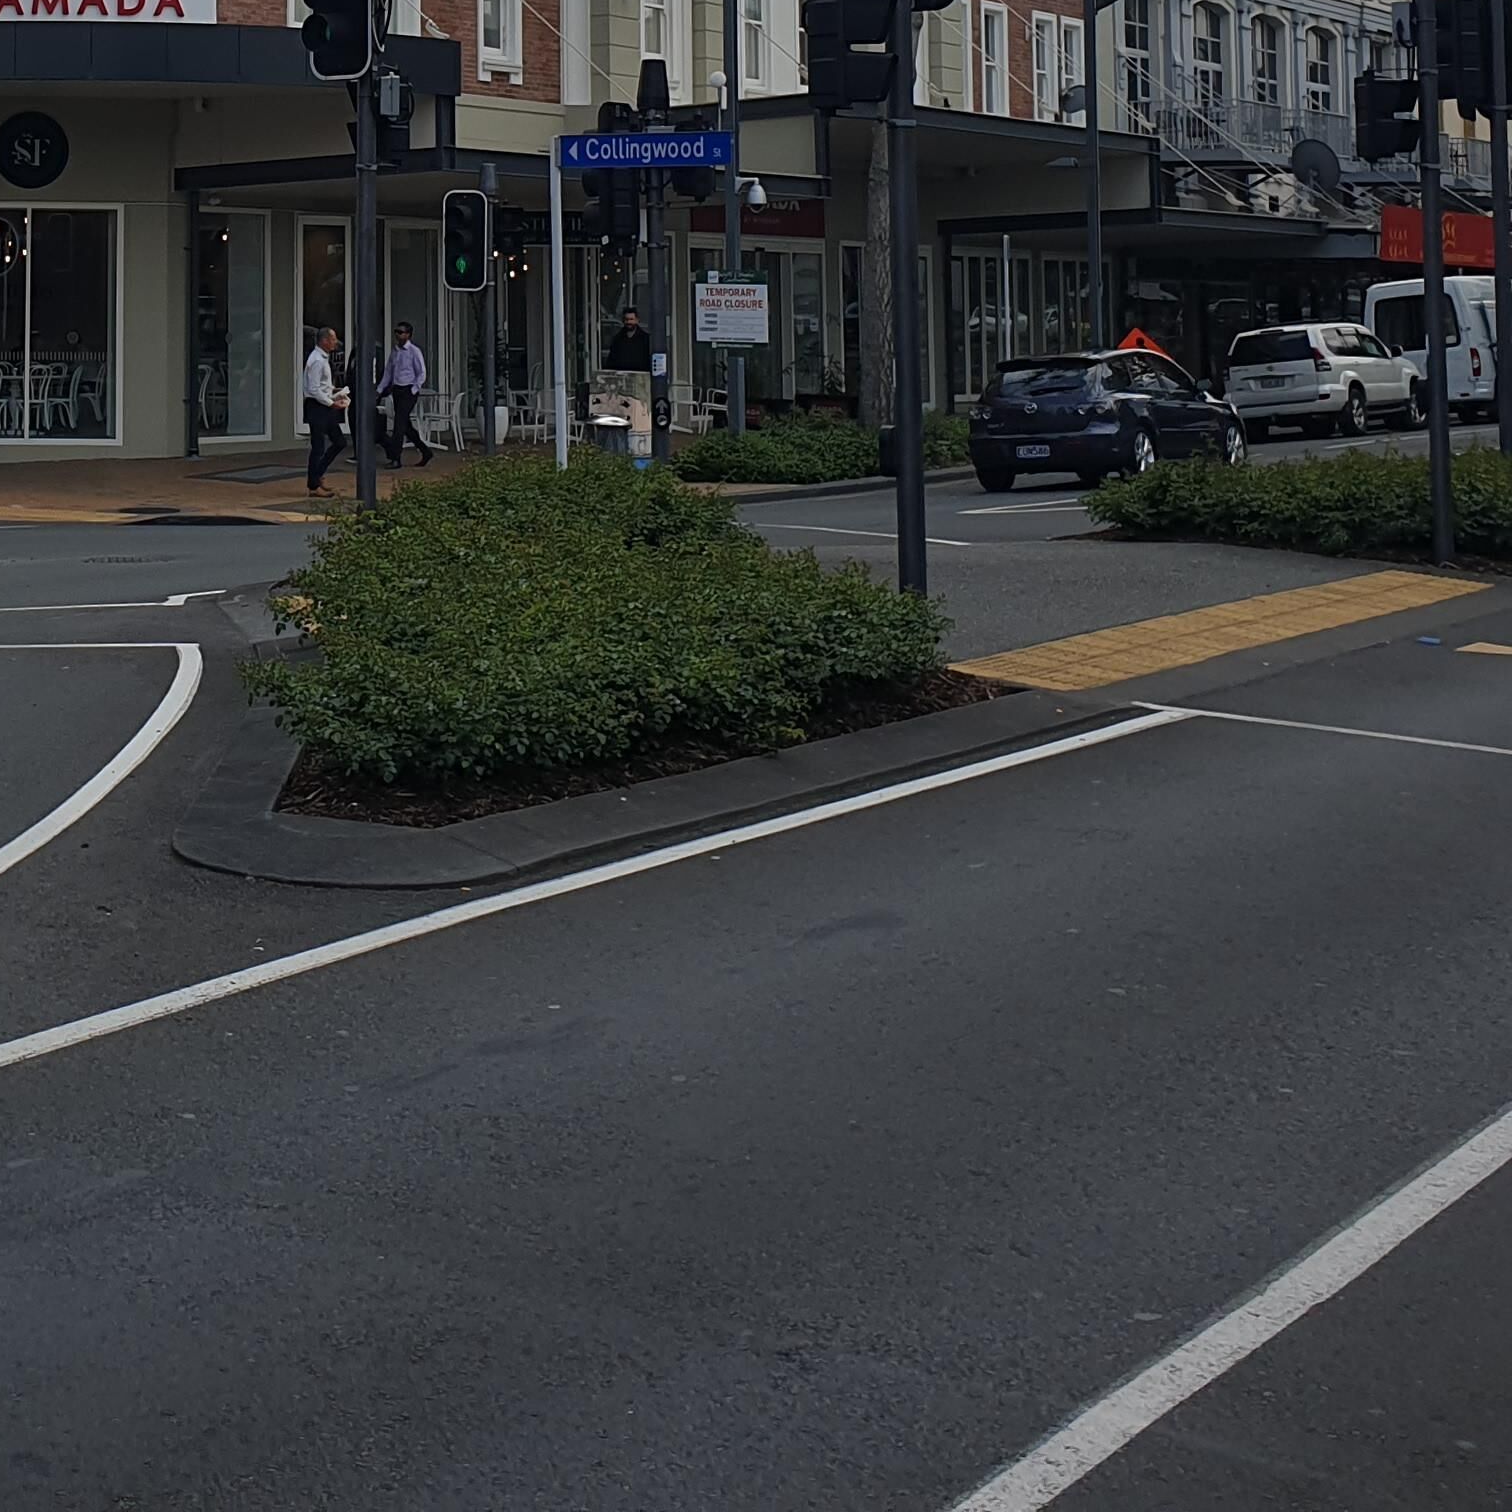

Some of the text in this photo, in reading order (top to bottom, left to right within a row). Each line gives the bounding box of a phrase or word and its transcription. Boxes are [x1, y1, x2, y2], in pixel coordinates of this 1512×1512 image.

[585, 136, 705, 164] Collingwood
[705, 287, 757, 297] TEMPORARY
[699, 299, 764, 309] ROAD CLOSURE
